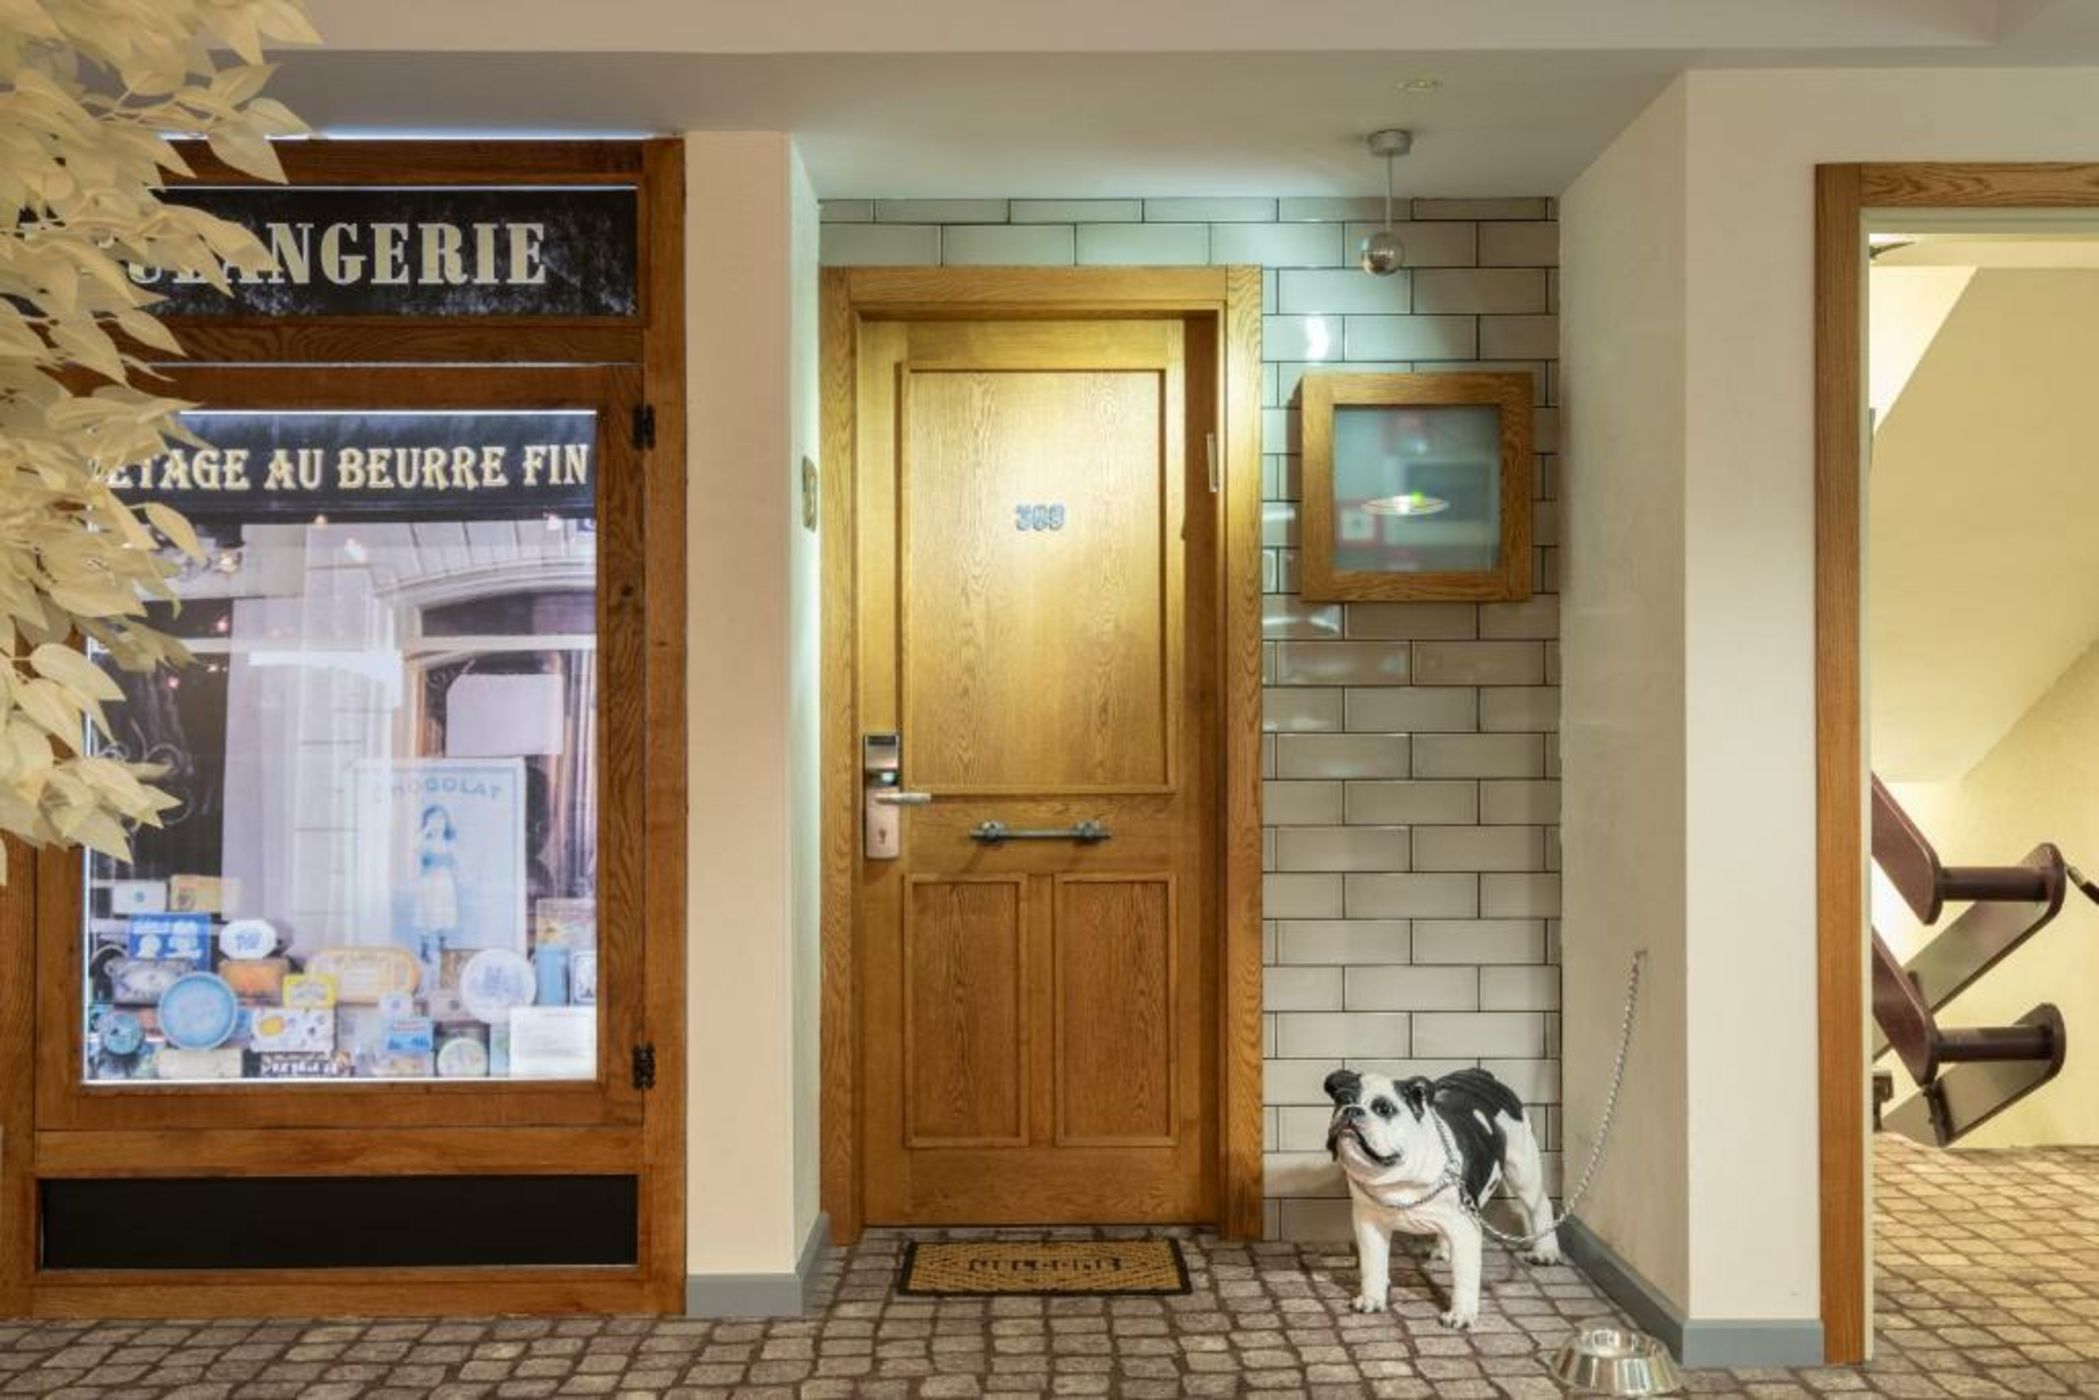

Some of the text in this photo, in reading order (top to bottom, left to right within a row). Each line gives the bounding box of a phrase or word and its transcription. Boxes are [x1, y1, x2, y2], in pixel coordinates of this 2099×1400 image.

[128, 222, 547, 285] NGERIE
[264, 447, 324, 490] AU
[336, 445, 509, 489] BEURRE
[523, 443, 589, 486] FIN
